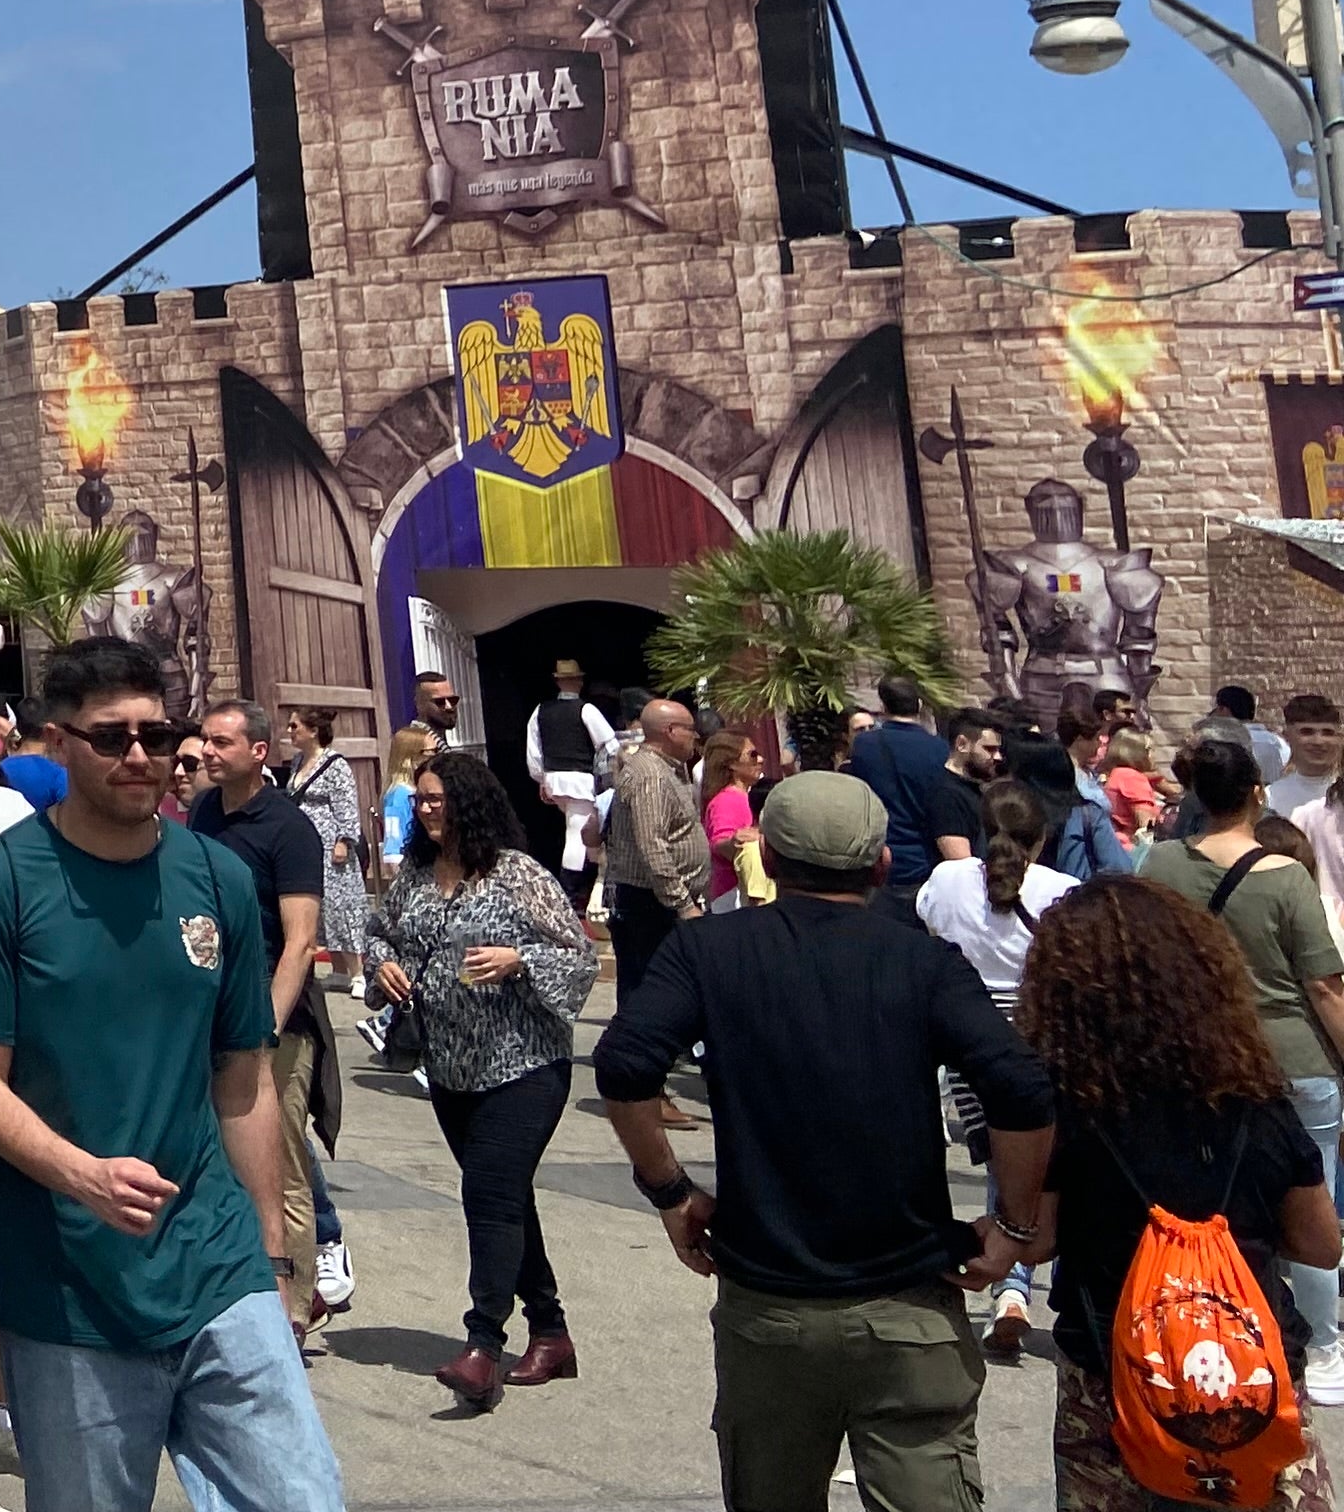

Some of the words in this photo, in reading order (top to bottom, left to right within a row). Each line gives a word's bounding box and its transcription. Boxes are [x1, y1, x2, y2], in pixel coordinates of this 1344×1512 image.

[441, 67, 584, 124] RUMA
[481, 112, 565, 160] NIA
[495, 176, 518, 195] que
[520, 174, 543, 191] una
